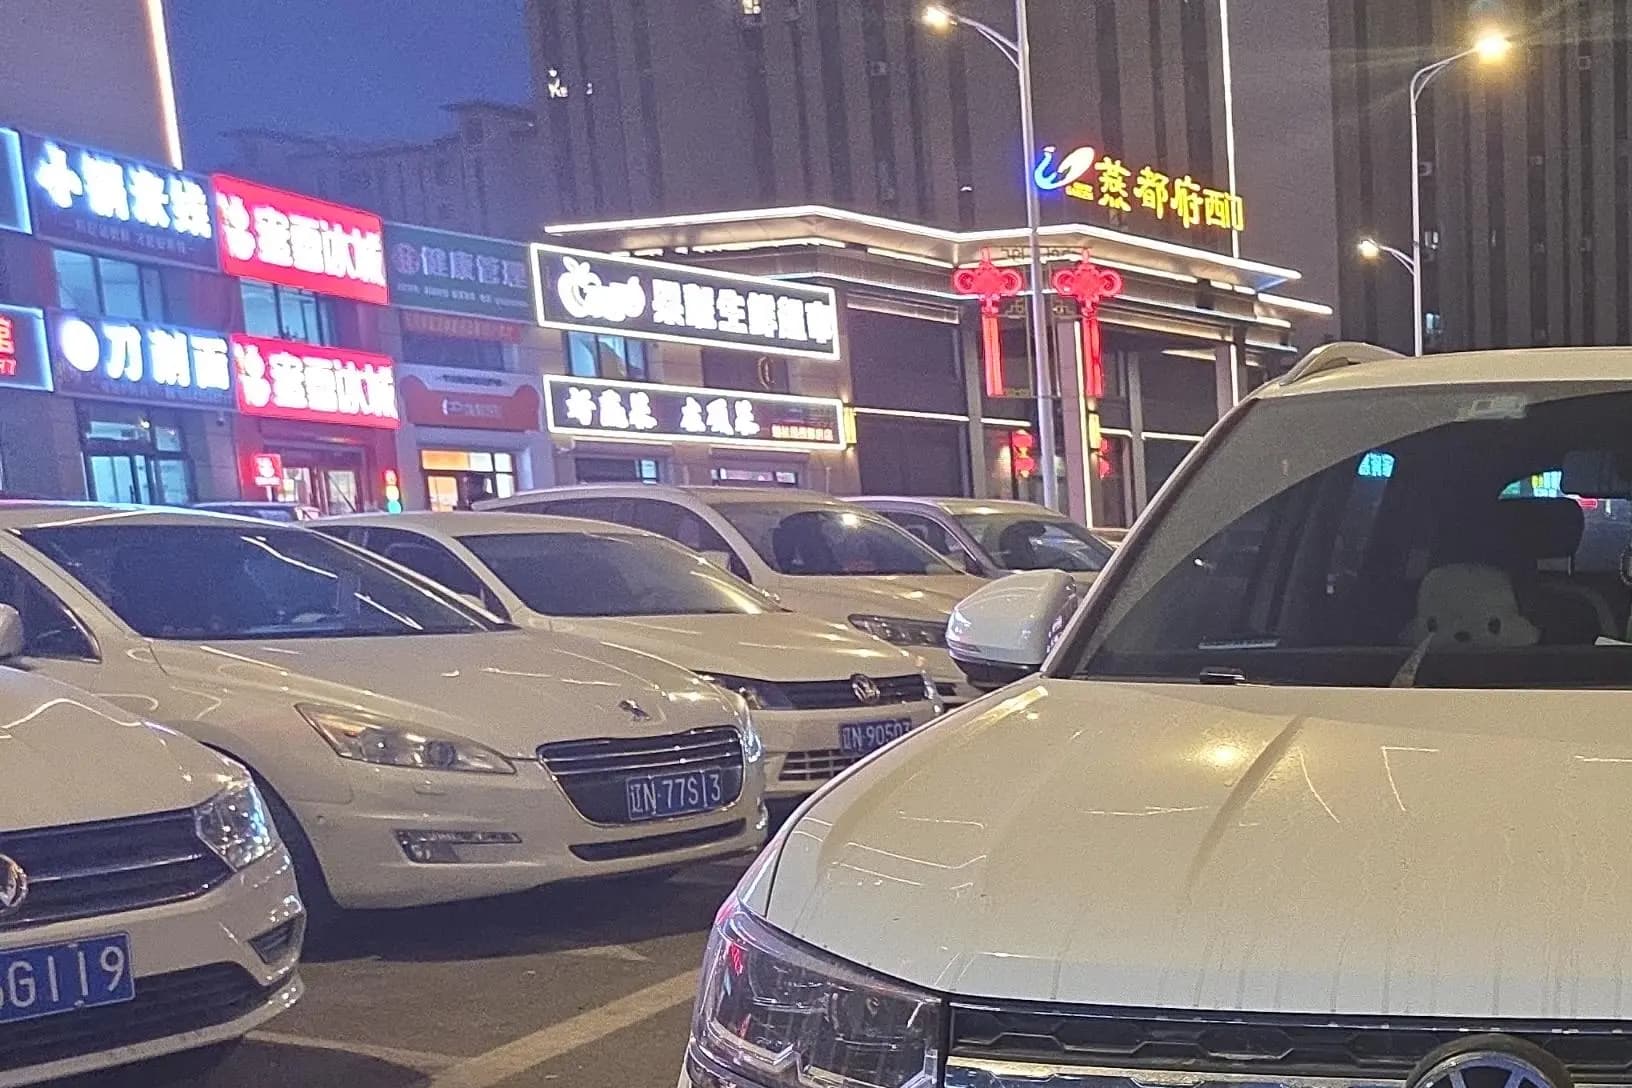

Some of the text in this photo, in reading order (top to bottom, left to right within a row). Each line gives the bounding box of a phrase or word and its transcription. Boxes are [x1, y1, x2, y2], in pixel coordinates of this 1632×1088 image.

[253, 206, 386, 287] 蜜雪冰城
[269, 351, 399, 420] 蜜雪冰城
[0, 946, 125, 1009] G119
